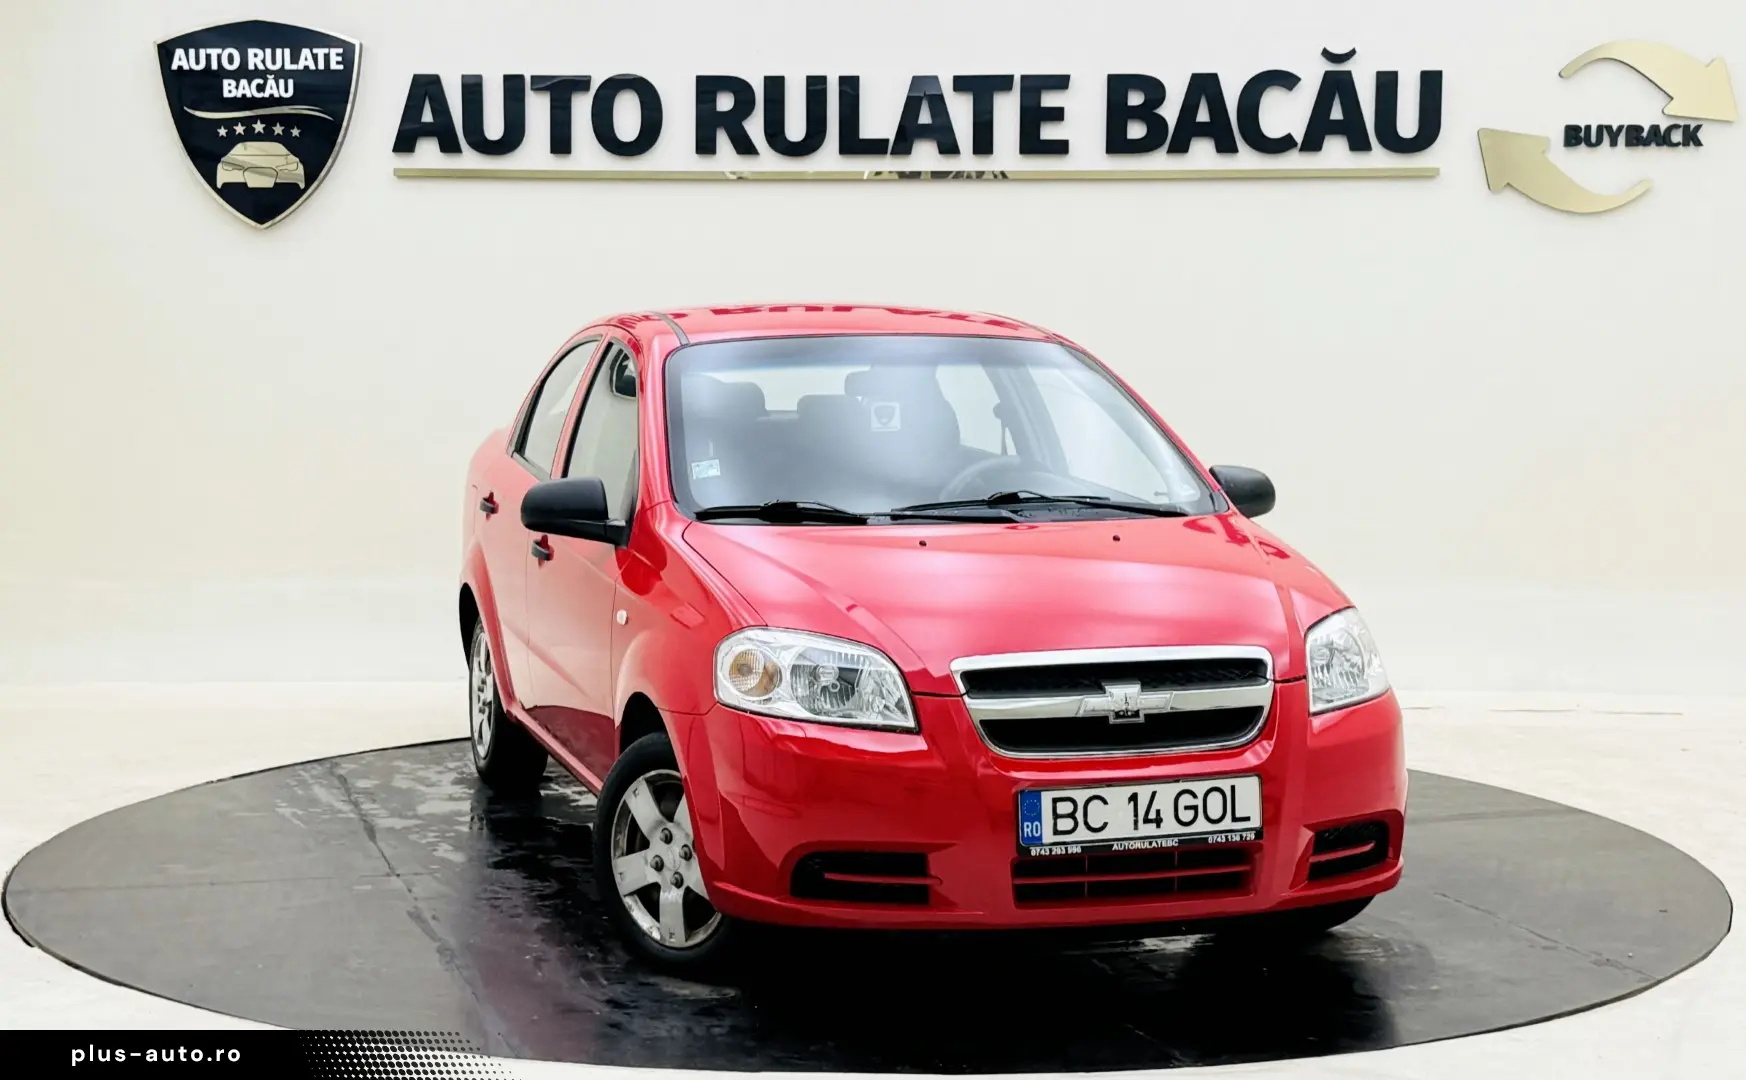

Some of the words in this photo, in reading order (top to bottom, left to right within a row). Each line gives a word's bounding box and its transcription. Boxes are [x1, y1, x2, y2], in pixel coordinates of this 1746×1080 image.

[171, 48, 241, 70] AUTO
[248, 48, 343, 70] RULATE
[222, 75, 294, 98] BACĂU
[391, 73, 664, 157] AUTO
[695, 74, 1071, 157] RULATE
[1105, 47, 1443, 154] BACĂU
[1563, 123, 1704, 148] BUYBACK
[1051, 794, 1109, 836] BC
[1127, 790, 1163, 831] 14
[1173, 784, 1251, 828] GOL
[1023, 821, 1041, 838] RO
